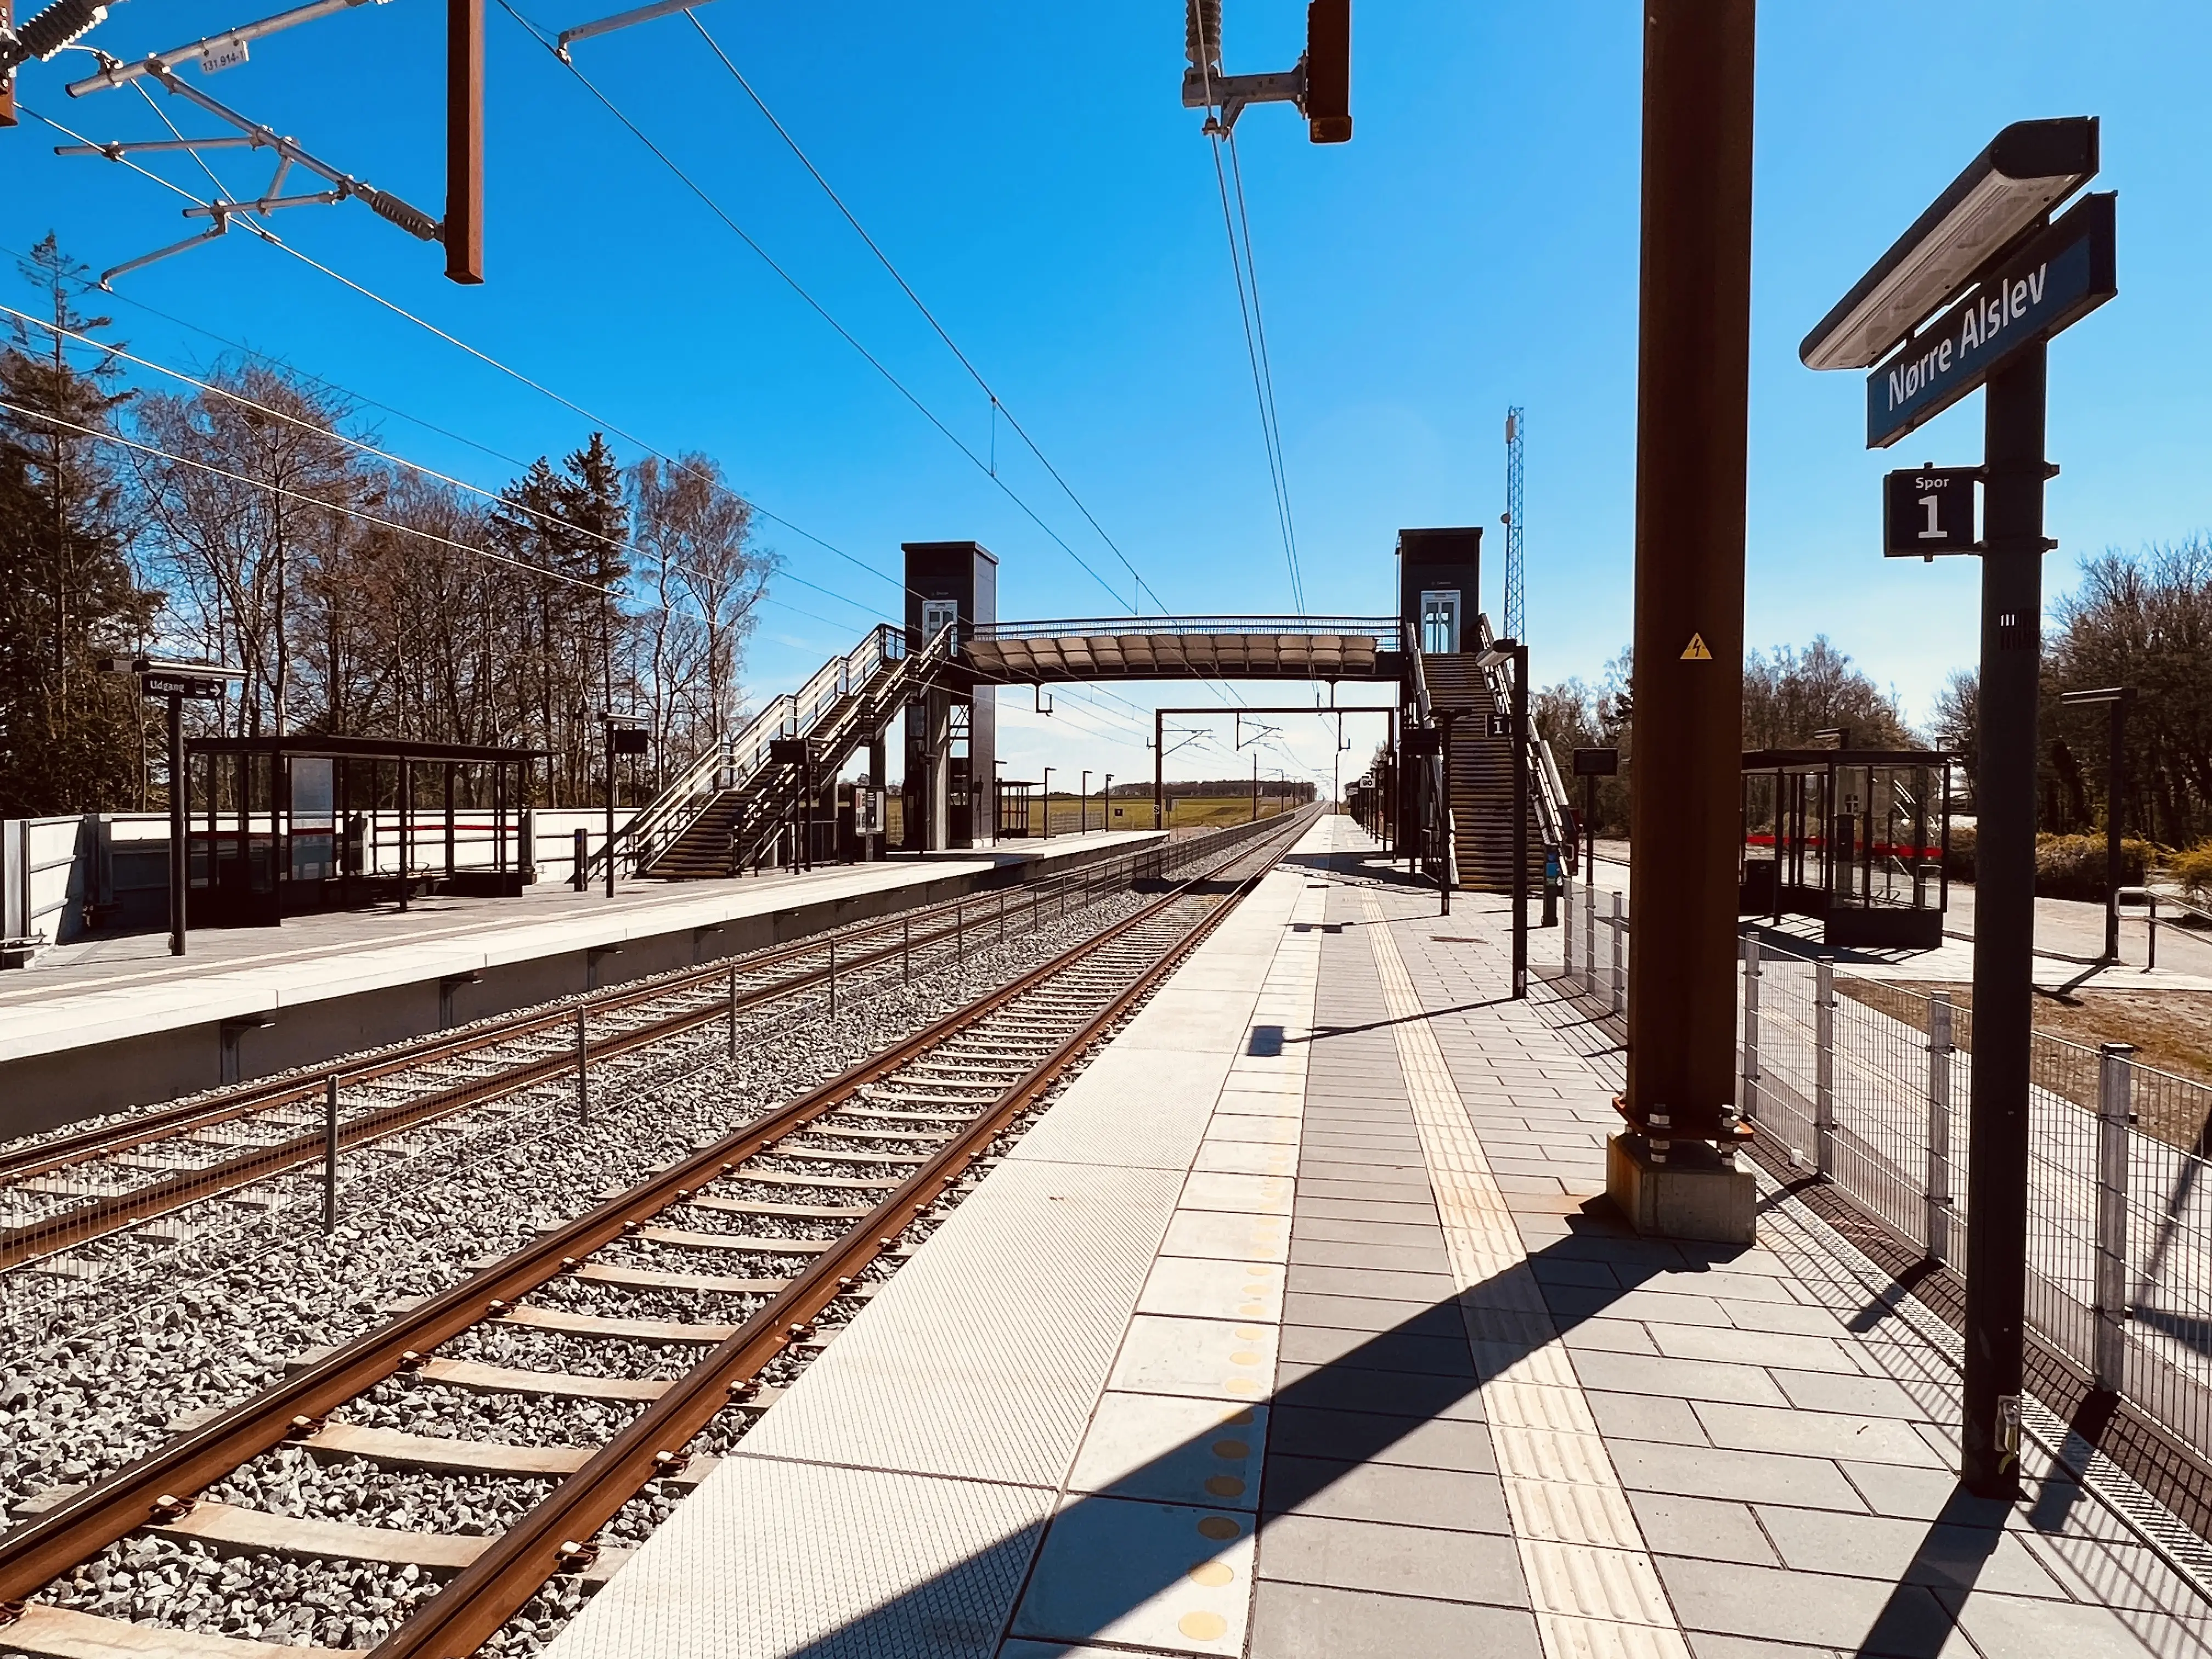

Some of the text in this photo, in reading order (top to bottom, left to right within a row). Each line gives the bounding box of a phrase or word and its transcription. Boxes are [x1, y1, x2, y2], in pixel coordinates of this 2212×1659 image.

[1889, 262, 2047, 411] Nørre Alslev
[1915, 477, 1950, 490] Spor
[1918, 495, 1948, 538] 1
[150, 680, 184, 693] Udgang
[1493, 721, 1503, 734] 1
